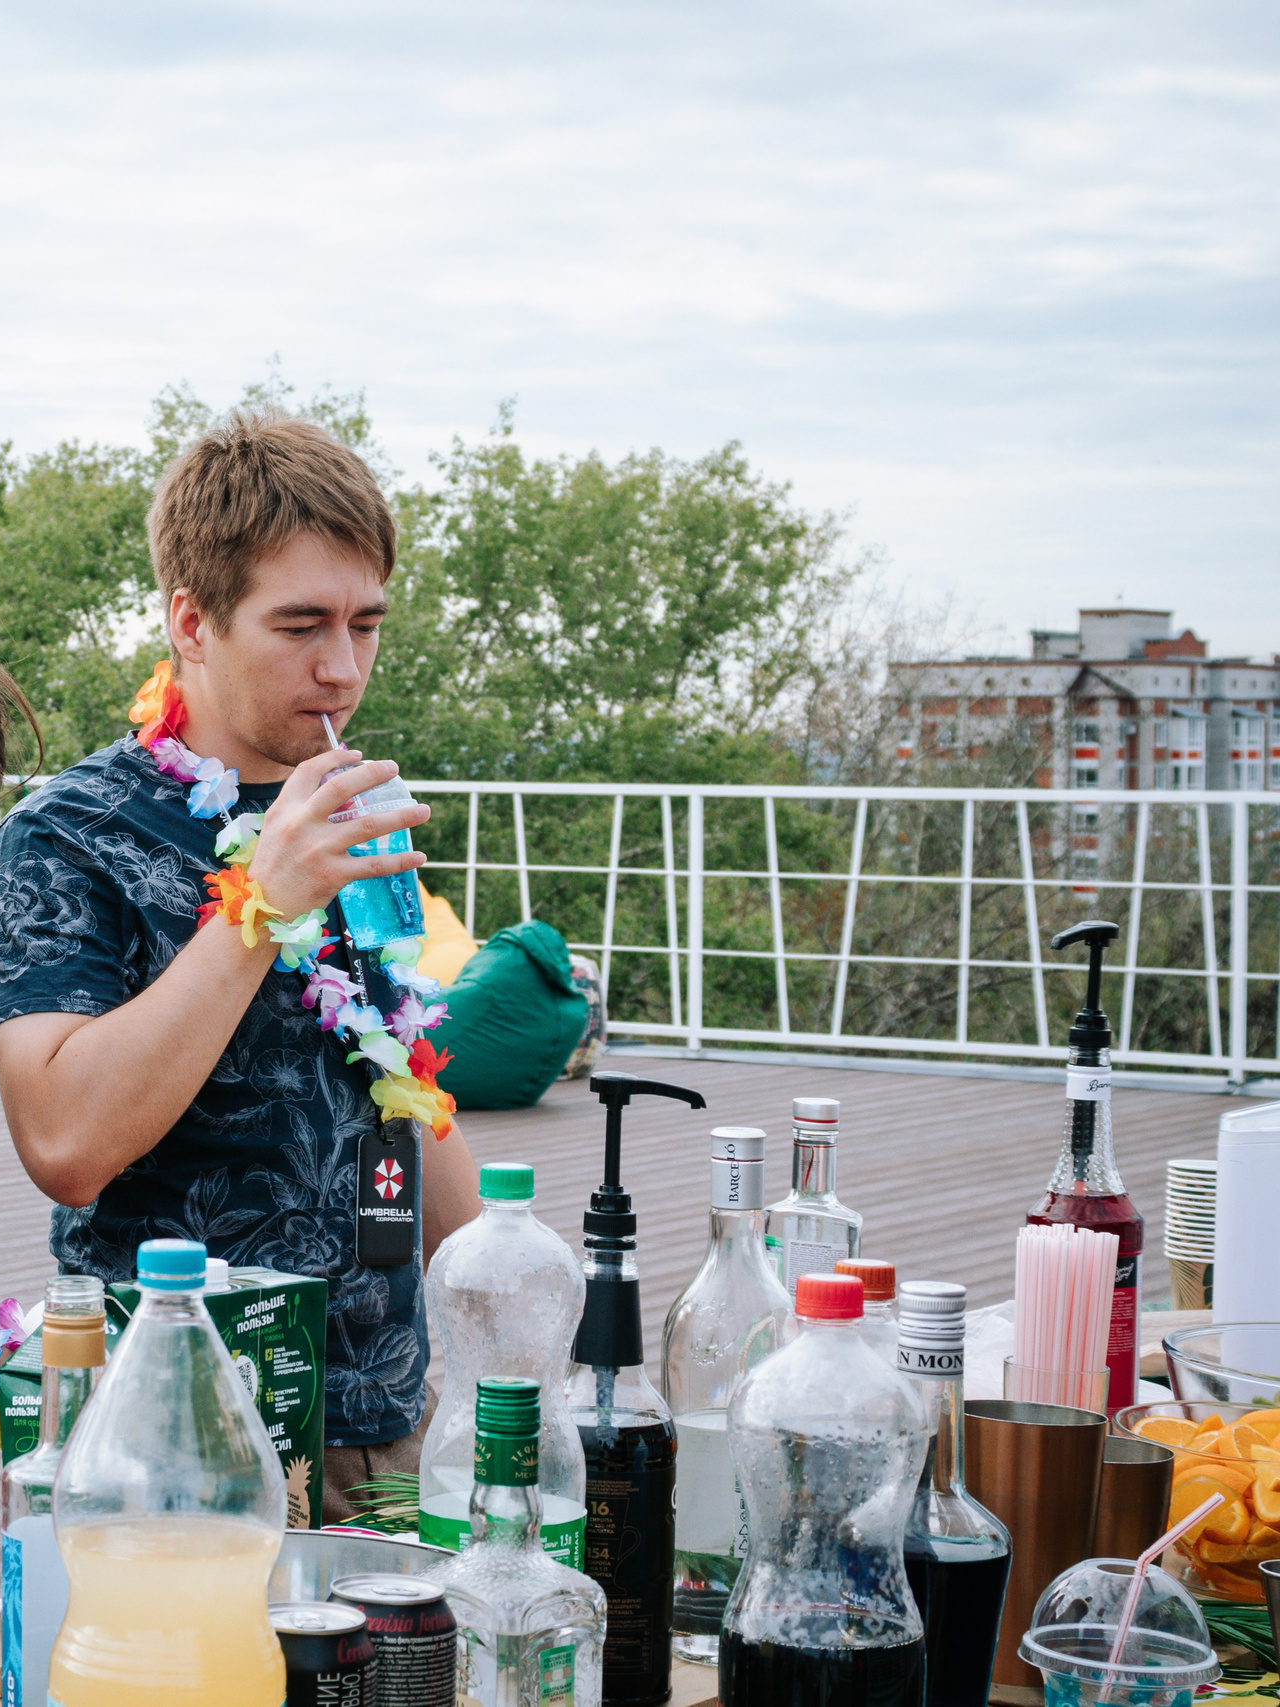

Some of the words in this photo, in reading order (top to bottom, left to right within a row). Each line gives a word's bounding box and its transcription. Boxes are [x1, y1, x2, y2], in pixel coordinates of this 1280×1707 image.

[724, 1143, 741, 1202] BARCELÓ
[360, 1208, 413, 1217] UMBRELLA
[231, 1313, 244, 1322] БЕРИ
[244, 1294, 286, 1318] БОЛЬШЕ
[237, 1312, 275, 1334] ПОЛЬЗЫ
[264, 1333, 285, 1342] УЖИНА
[5, 1407, 39, 1417] ПОЛЬЗЫ
[13, 1419, 27, 1427] ДЛЯ
[273, 1438, 292, 1452] СИЛ
[590, 1501, 610, 1516] 16
[586, 1547, 610, 1560] 154
[543, 1658, 572, 1669] ФЕДЕРАЦИЯ
